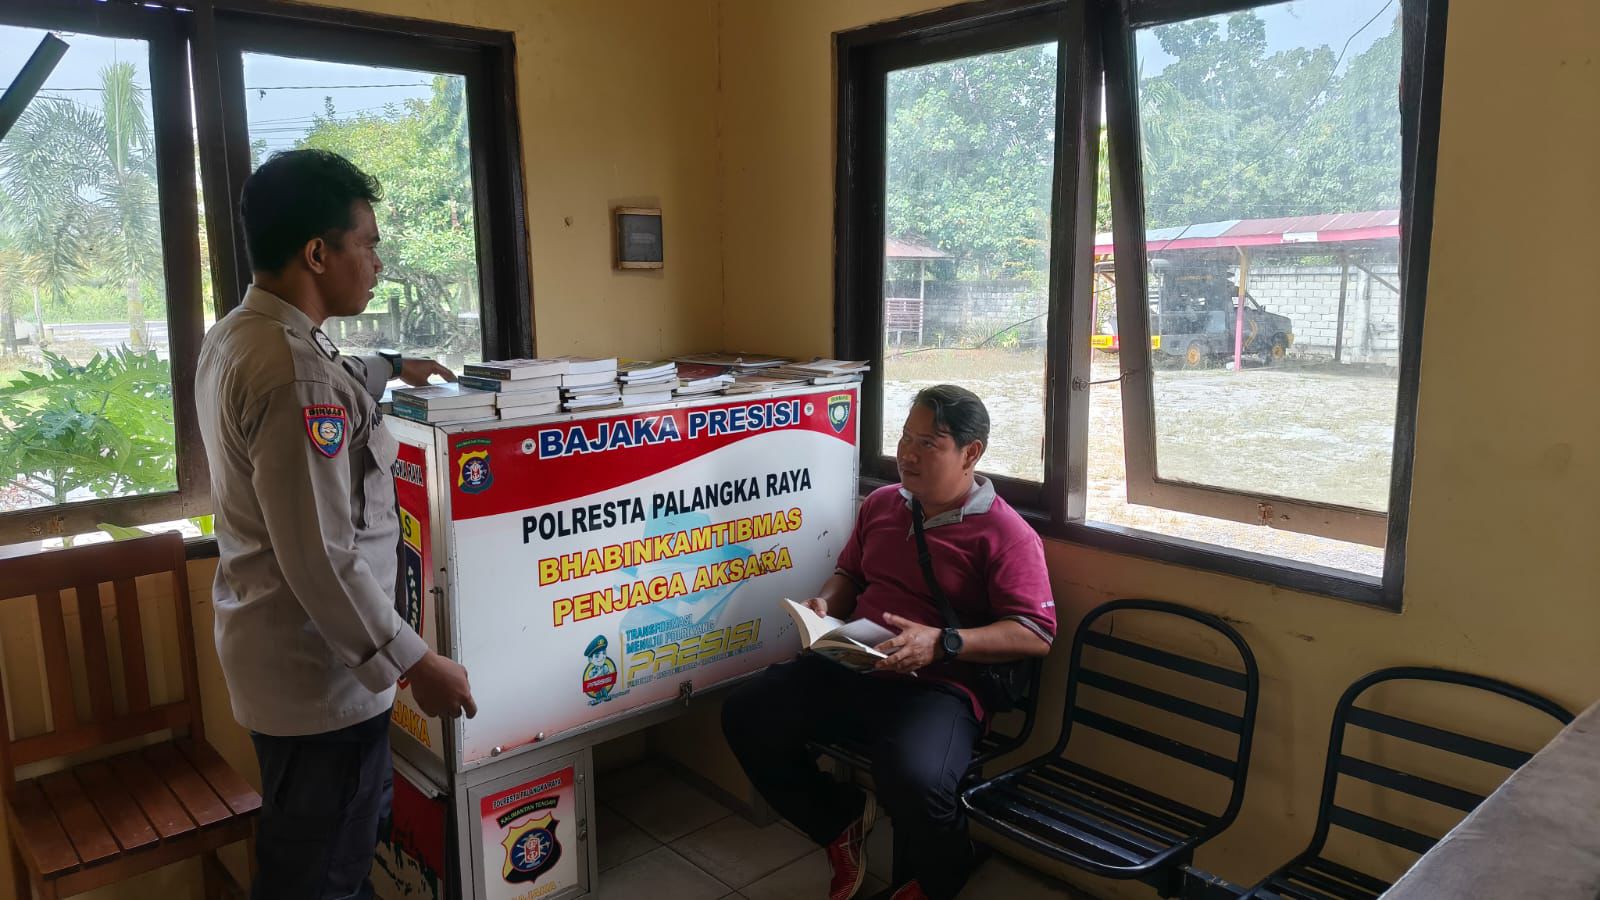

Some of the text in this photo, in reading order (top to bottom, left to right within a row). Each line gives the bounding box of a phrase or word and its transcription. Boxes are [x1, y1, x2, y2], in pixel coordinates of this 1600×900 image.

[539, 400, 800, 460] BAJAKA PRESISI
[523, 468, 812, 543] POLRESTA PALANGKA RAYA
[538, 507, 802, 586] BHABINKAMTIBMAS
[553, 547, 793, 627] PENJAGA AKSARA
[627, 617, 762, 683] PRESISI
